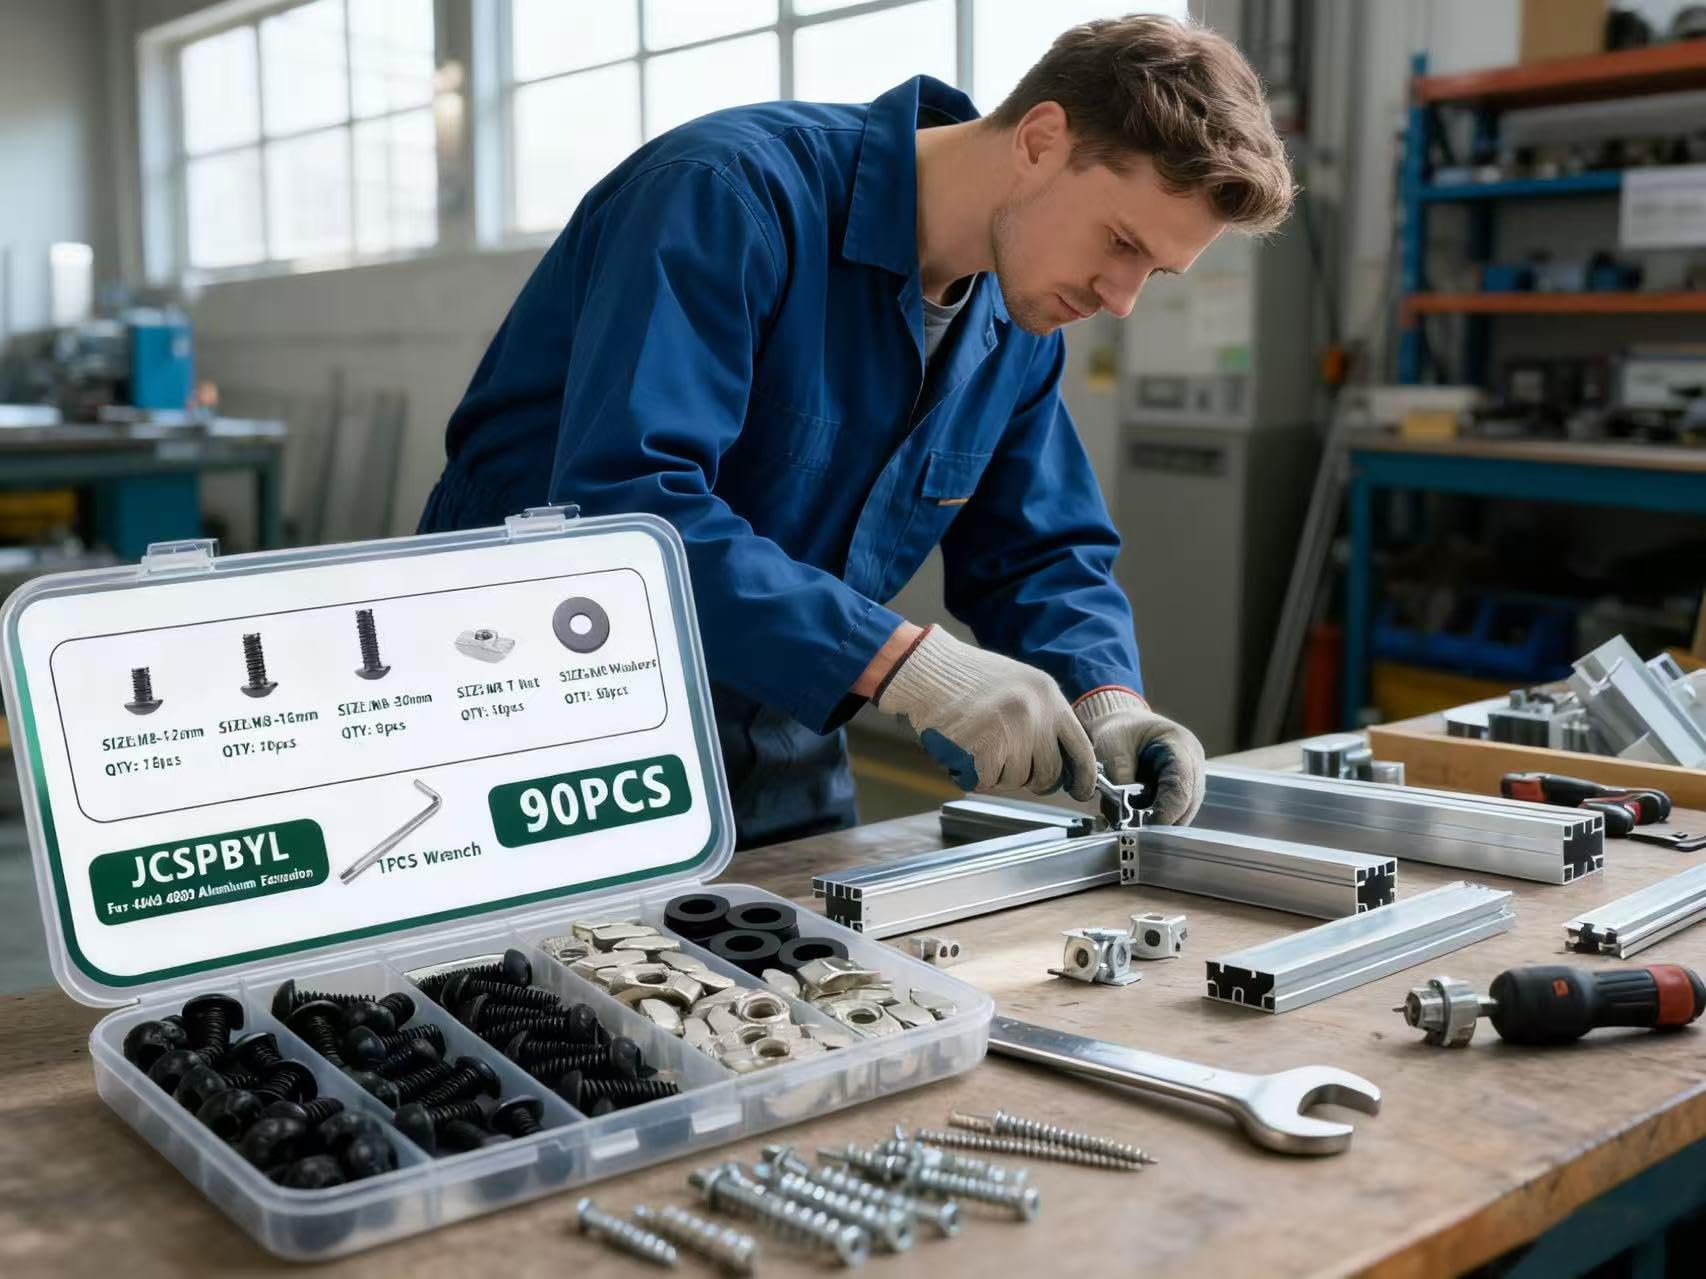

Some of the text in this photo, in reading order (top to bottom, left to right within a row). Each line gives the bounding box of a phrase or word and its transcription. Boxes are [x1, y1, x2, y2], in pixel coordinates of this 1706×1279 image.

[341, 725, 371, 739] QTY:
[519, 765, 672, 833] 90PCS
[131, 831, 290, 888] JCSPBYL
[423, 841, 482, 865] Wrench
